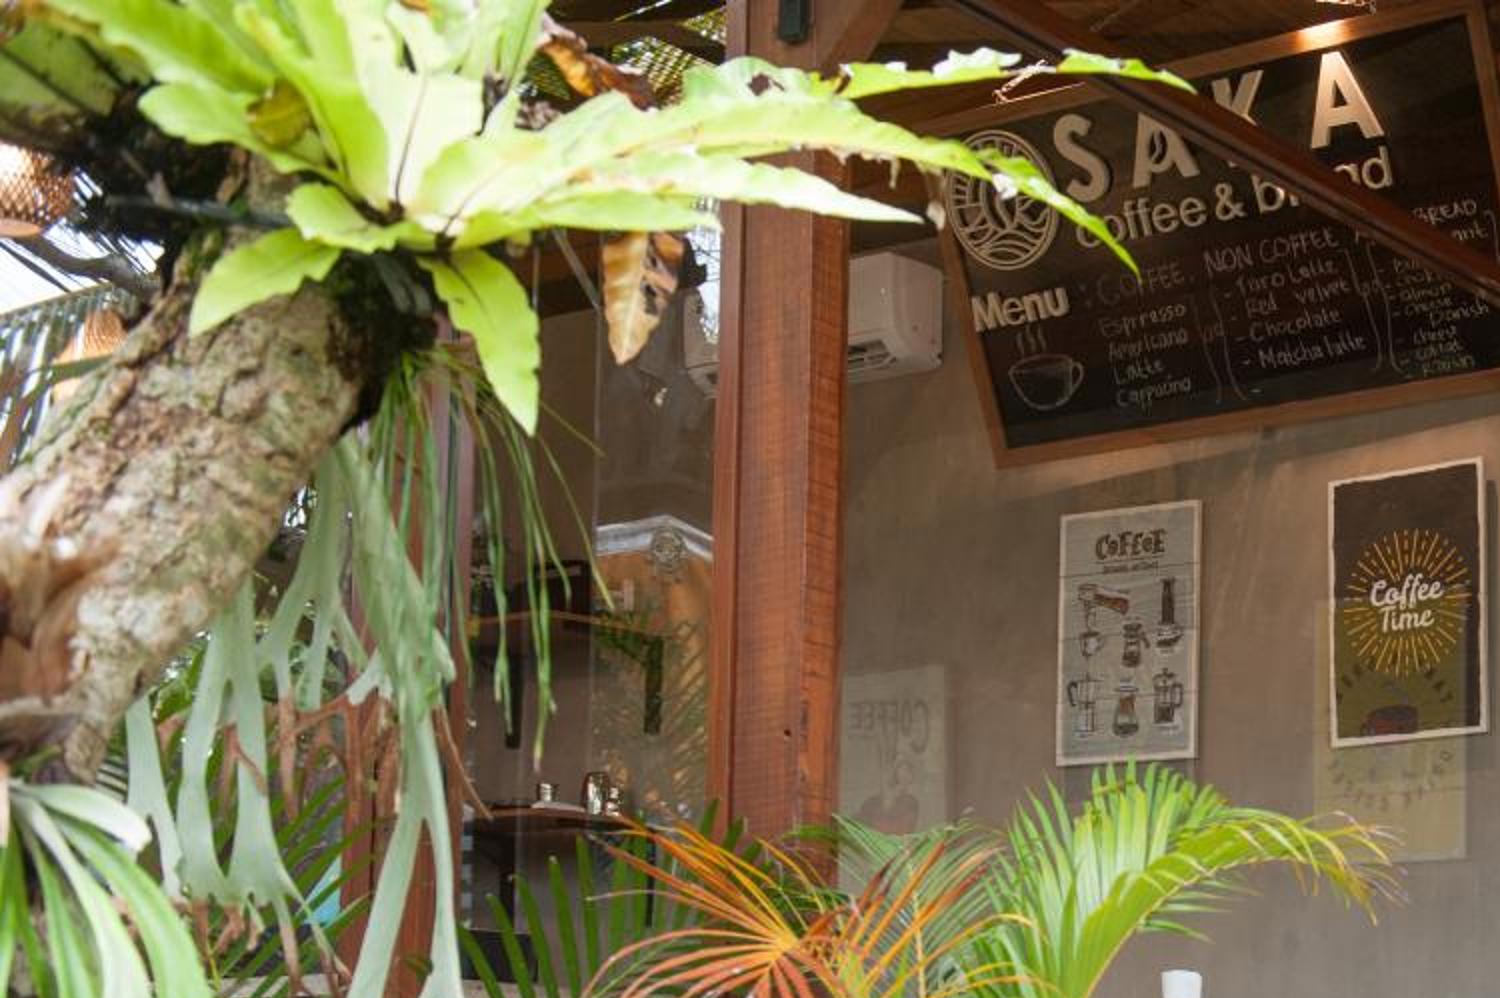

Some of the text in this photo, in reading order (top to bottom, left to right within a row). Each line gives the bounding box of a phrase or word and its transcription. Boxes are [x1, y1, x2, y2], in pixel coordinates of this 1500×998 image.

[1214, 183, 1246, 221] &
[1204, 227, 1339, 277] NON COFFEE
[971, 287, 1069, 333] Menu
[1249, 307, 1342, 342] Chocolate
[1370, 573, 1444, 610] Coffee
[1379, 605, 1435, 633] Time
